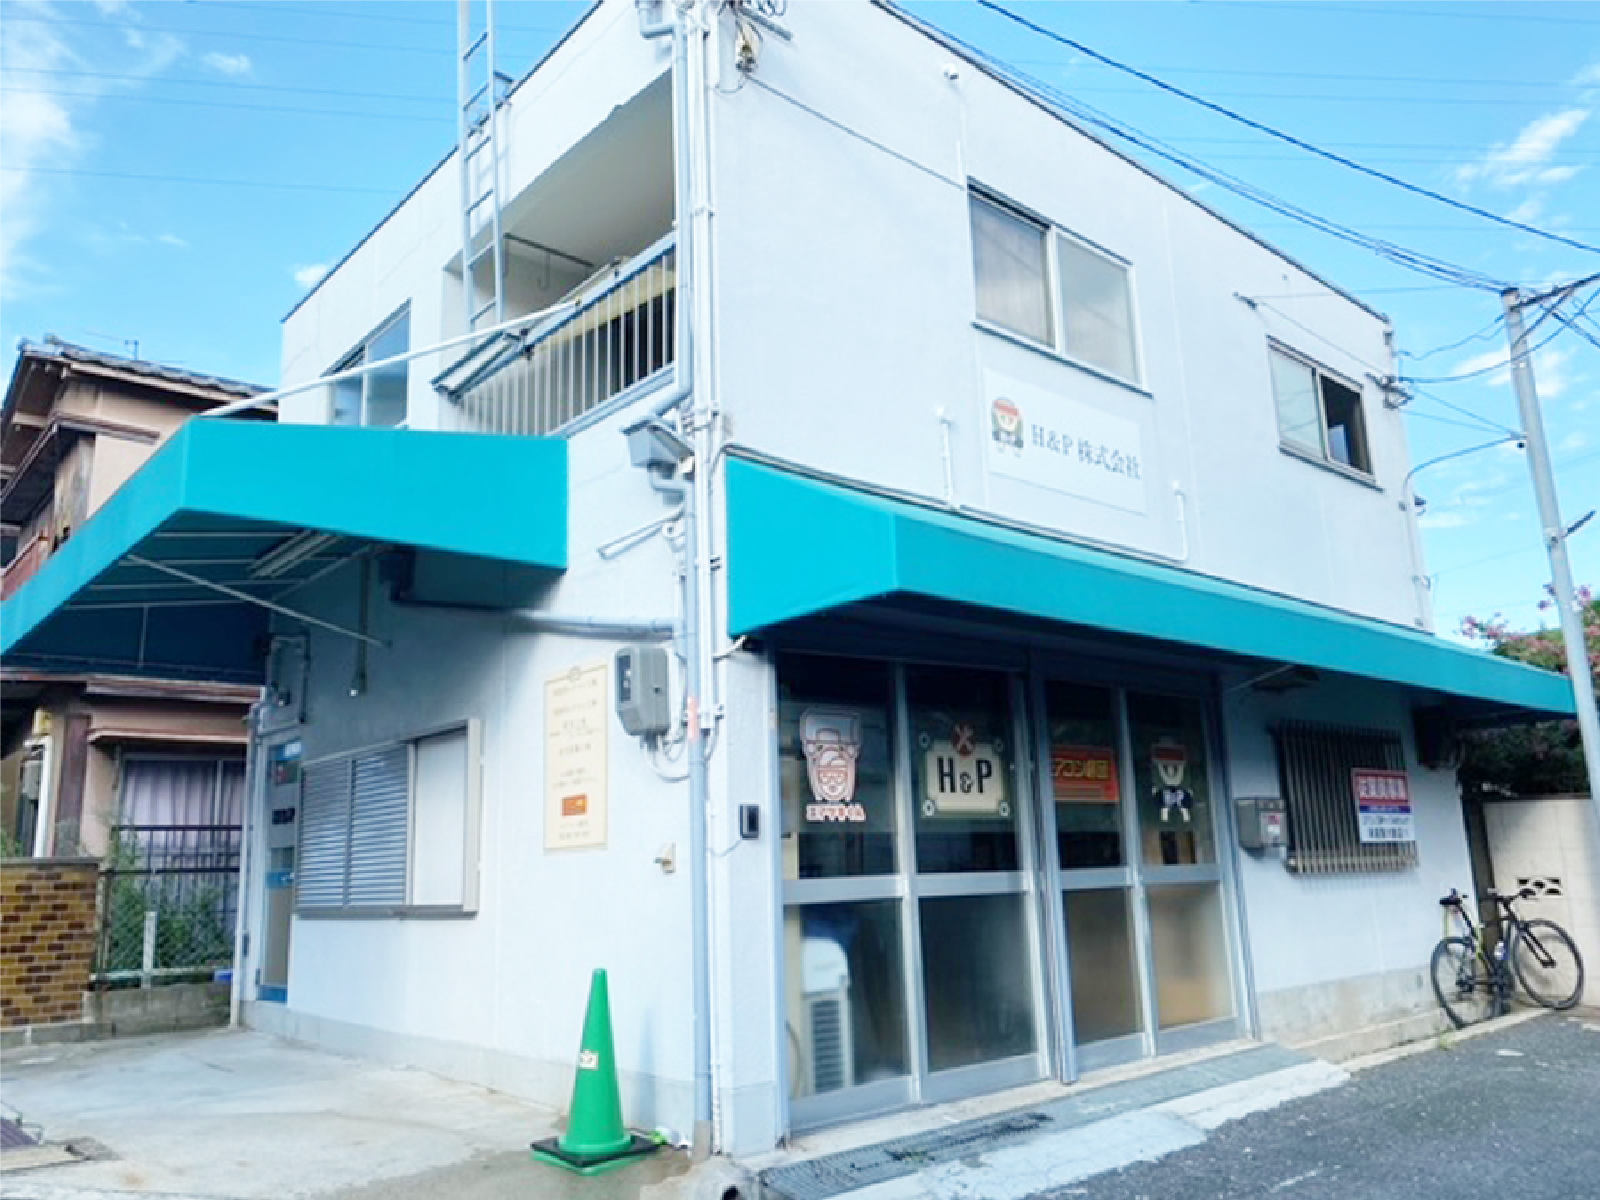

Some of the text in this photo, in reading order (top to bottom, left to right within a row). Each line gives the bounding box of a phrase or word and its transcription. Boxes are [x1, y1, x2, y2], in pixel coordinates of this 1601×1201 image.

[1031, 424, 1141, 480] H&P 株式会社
[936, 755, 993, 794] H&P
